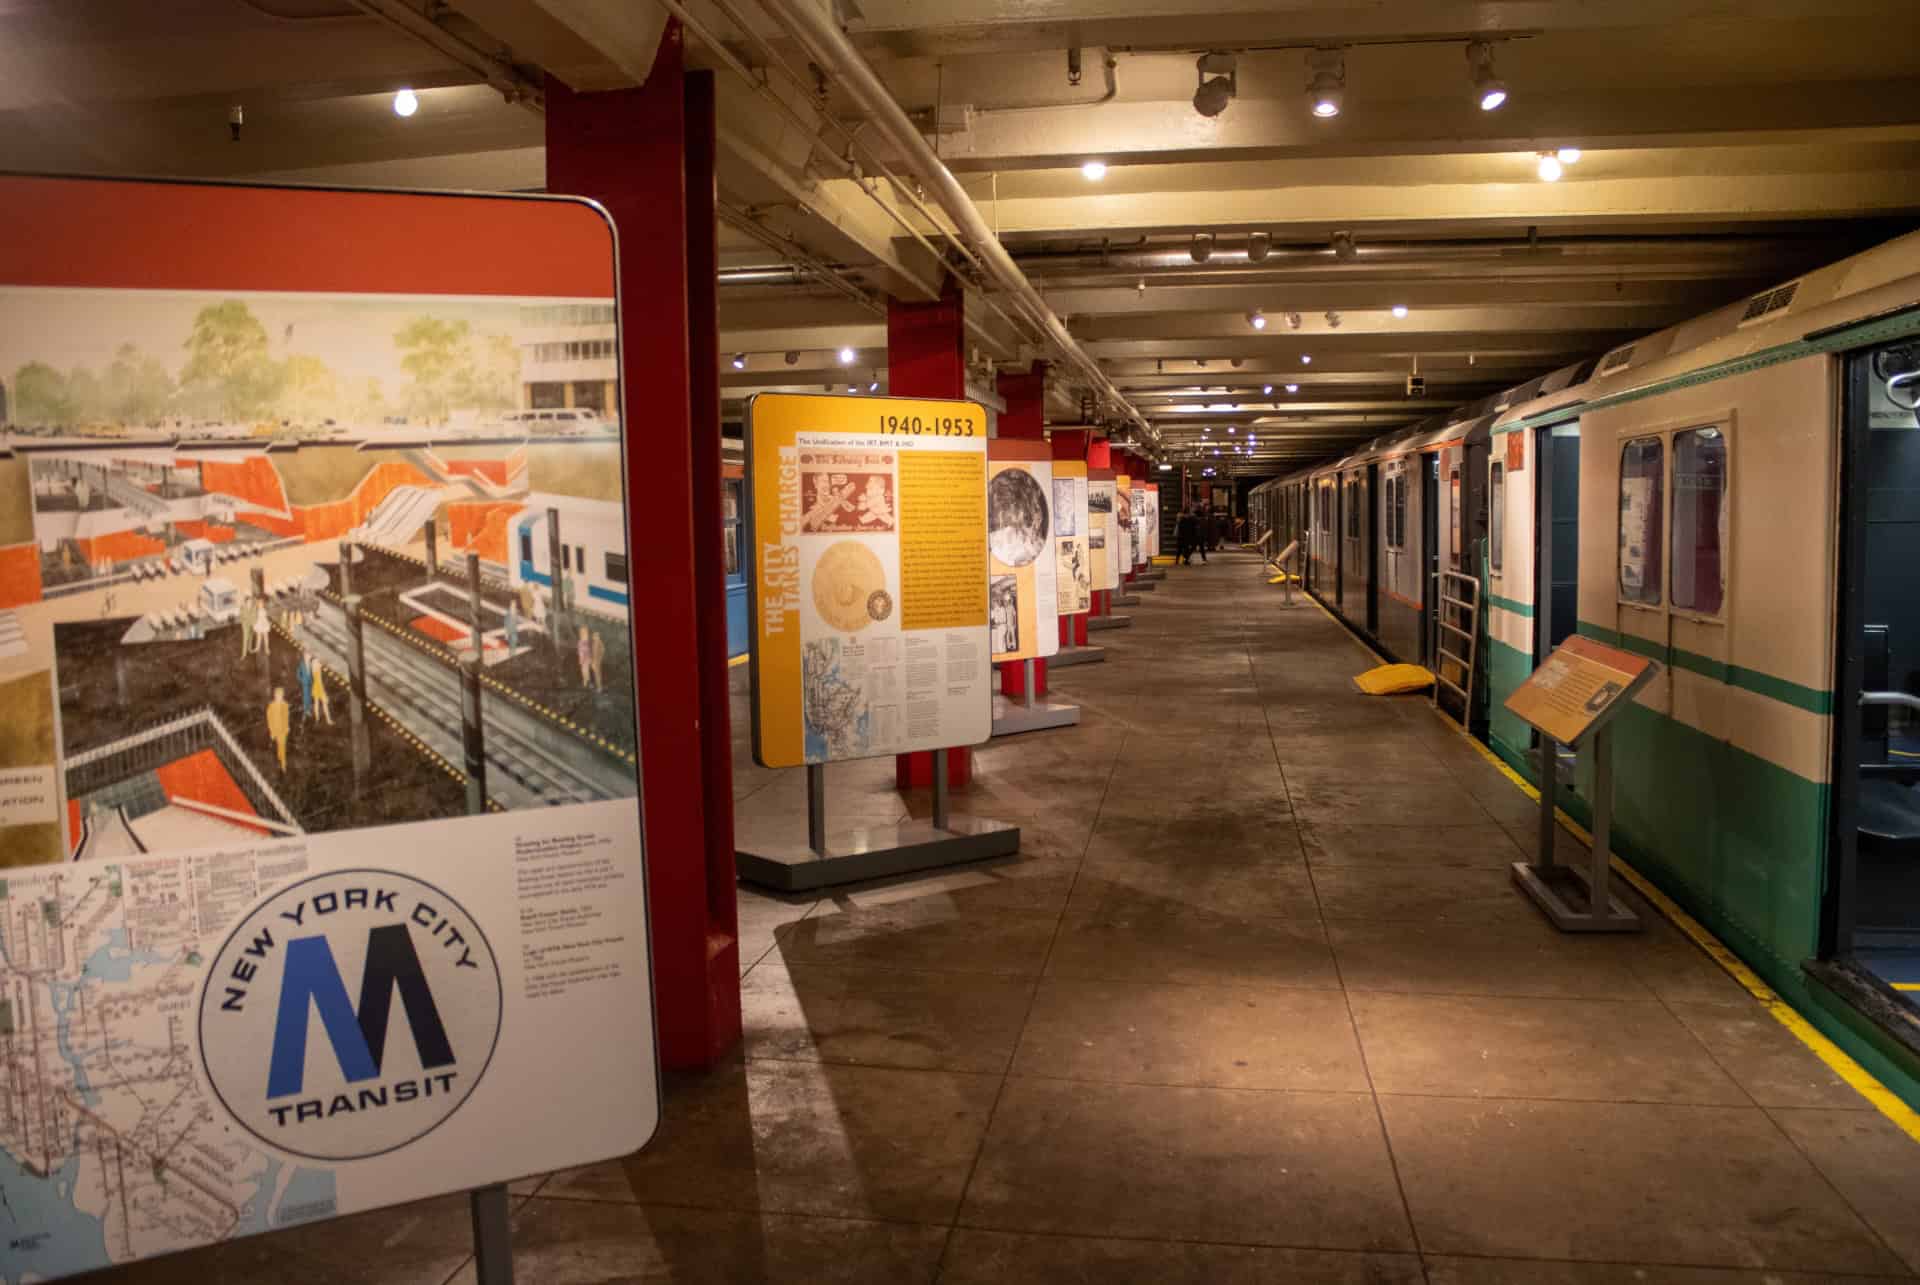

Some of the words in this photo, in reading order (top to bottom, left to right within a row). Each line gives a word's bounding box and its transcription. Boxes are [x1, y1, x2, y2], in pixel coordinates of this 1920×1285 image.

[880, 415, 974, 437] 1940-1953
[779, 454, 800, 536] CHARGE
[763, 542, 785, 588] CITY
[782, 545, 800, 611] TAKES
[765, 594, 784, 636] THE
[220, 928, 275, 1012] NEW
[280, 888, 400, 926] YORK
[411, 902, 478, 970] CITY
[268, 1072, 458, 1127] TRANSIT
